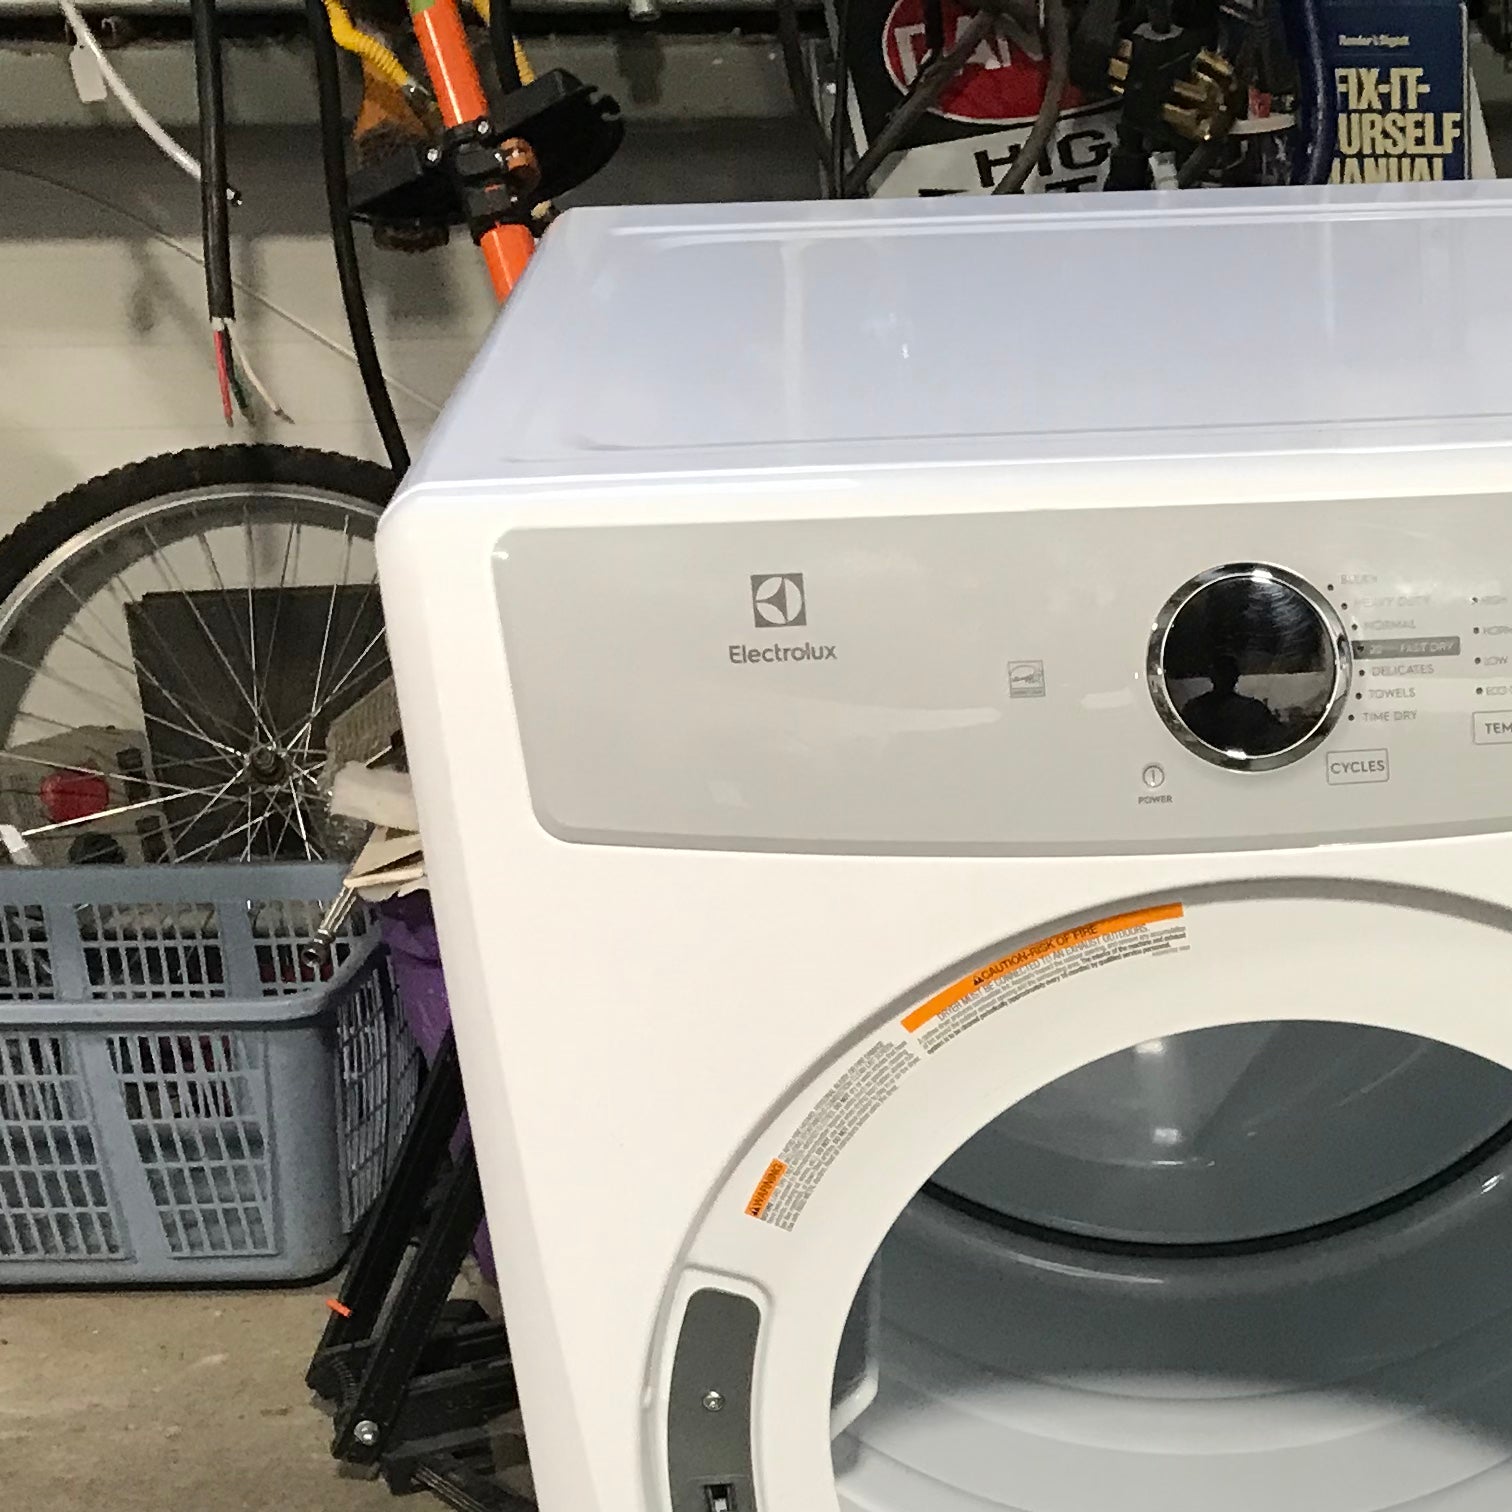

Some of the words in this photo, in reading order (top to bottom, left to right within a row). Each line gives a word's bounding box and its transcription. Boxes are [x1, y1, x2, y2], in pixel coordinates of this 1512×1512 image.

[1335, 67, 1431, 110] FIX-IT-
[1337, 112, 1461, 155] URSELF
[974, 129, 1113, 188] HIG
[728, 642, 838, 664] Electrolux
[1484, 656, 1508, 666] LOW
[1371, 664, 1434, 677] DELICATES
[1368, 688, 1416, 699] TOWELS
[1363, 711, 1390, 722] TIME
[1393, 710, 1418, 721] DRY
[1330, 760, 1385, 775] CYCLES
[1137, 795, 1173, 806] POWER
[1055, 932, 1070, 945] OF
[1071, 925, 1097, 940] FIRE
[752, 1161, 783, 1208] WARNING
